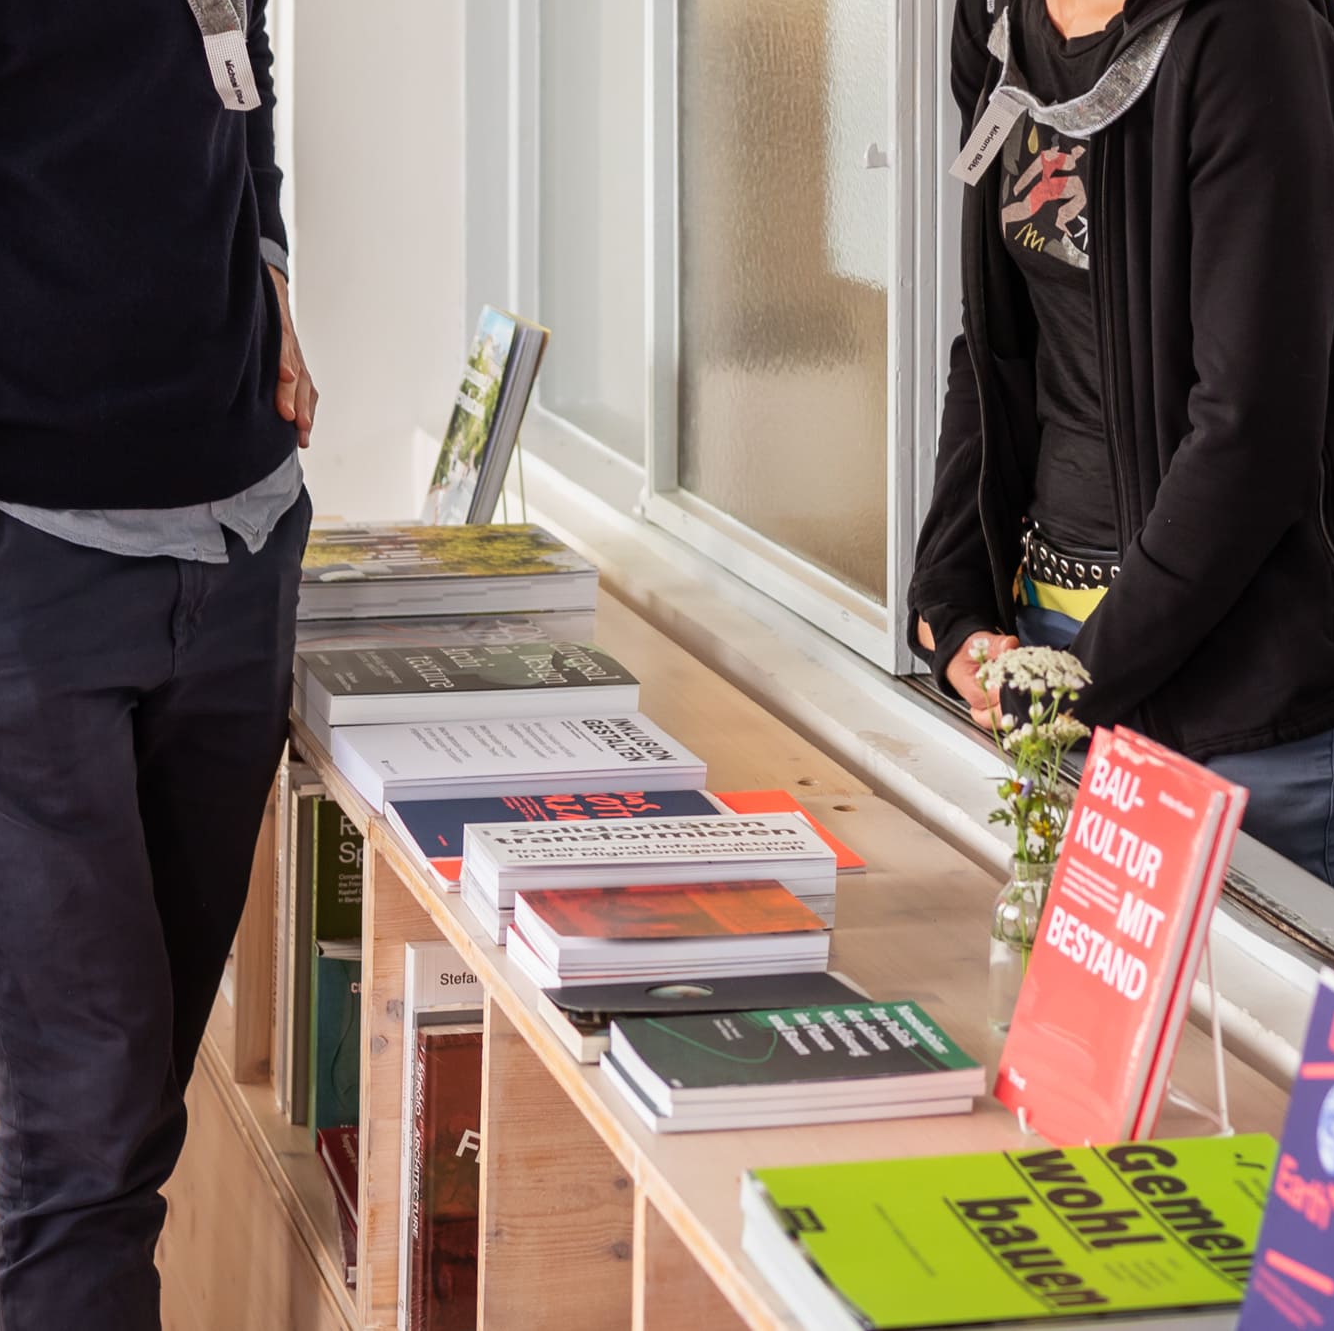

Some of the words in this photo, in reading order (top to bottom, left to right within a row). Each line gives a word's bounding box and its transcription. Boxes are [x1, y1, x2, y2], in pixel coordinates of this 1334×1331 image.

[980, 124, 1000, 152] Miriam
[582, 719, 650, 762] GESTALTEN
[607, 718, 678, 761] INKLUSION
[1089, 757, 1145, 813] BAU-
[494, 828, 798, 845] transformieren
[508, 845, 605, 854] Praktiken
[656, 840, 805, 849] Infrastrukturen
[510, 820, 765, 836] Solidaritäten
[581, 844, 805, 858] Migrationsgesellschaft
[1074, 807, 1164, 888] KULTUR
[1117, 891, 1165, 948] MIT
[1046, 907, 1149, 1001] BESTAND
[411, 1127, 423, 1239] ARCHITECTURE
[1017, 1149, 1167, 1250] wohl
[1274, 1153, 1333, 1231] Earth
[956, 1197, 1110, 1308] bauen
